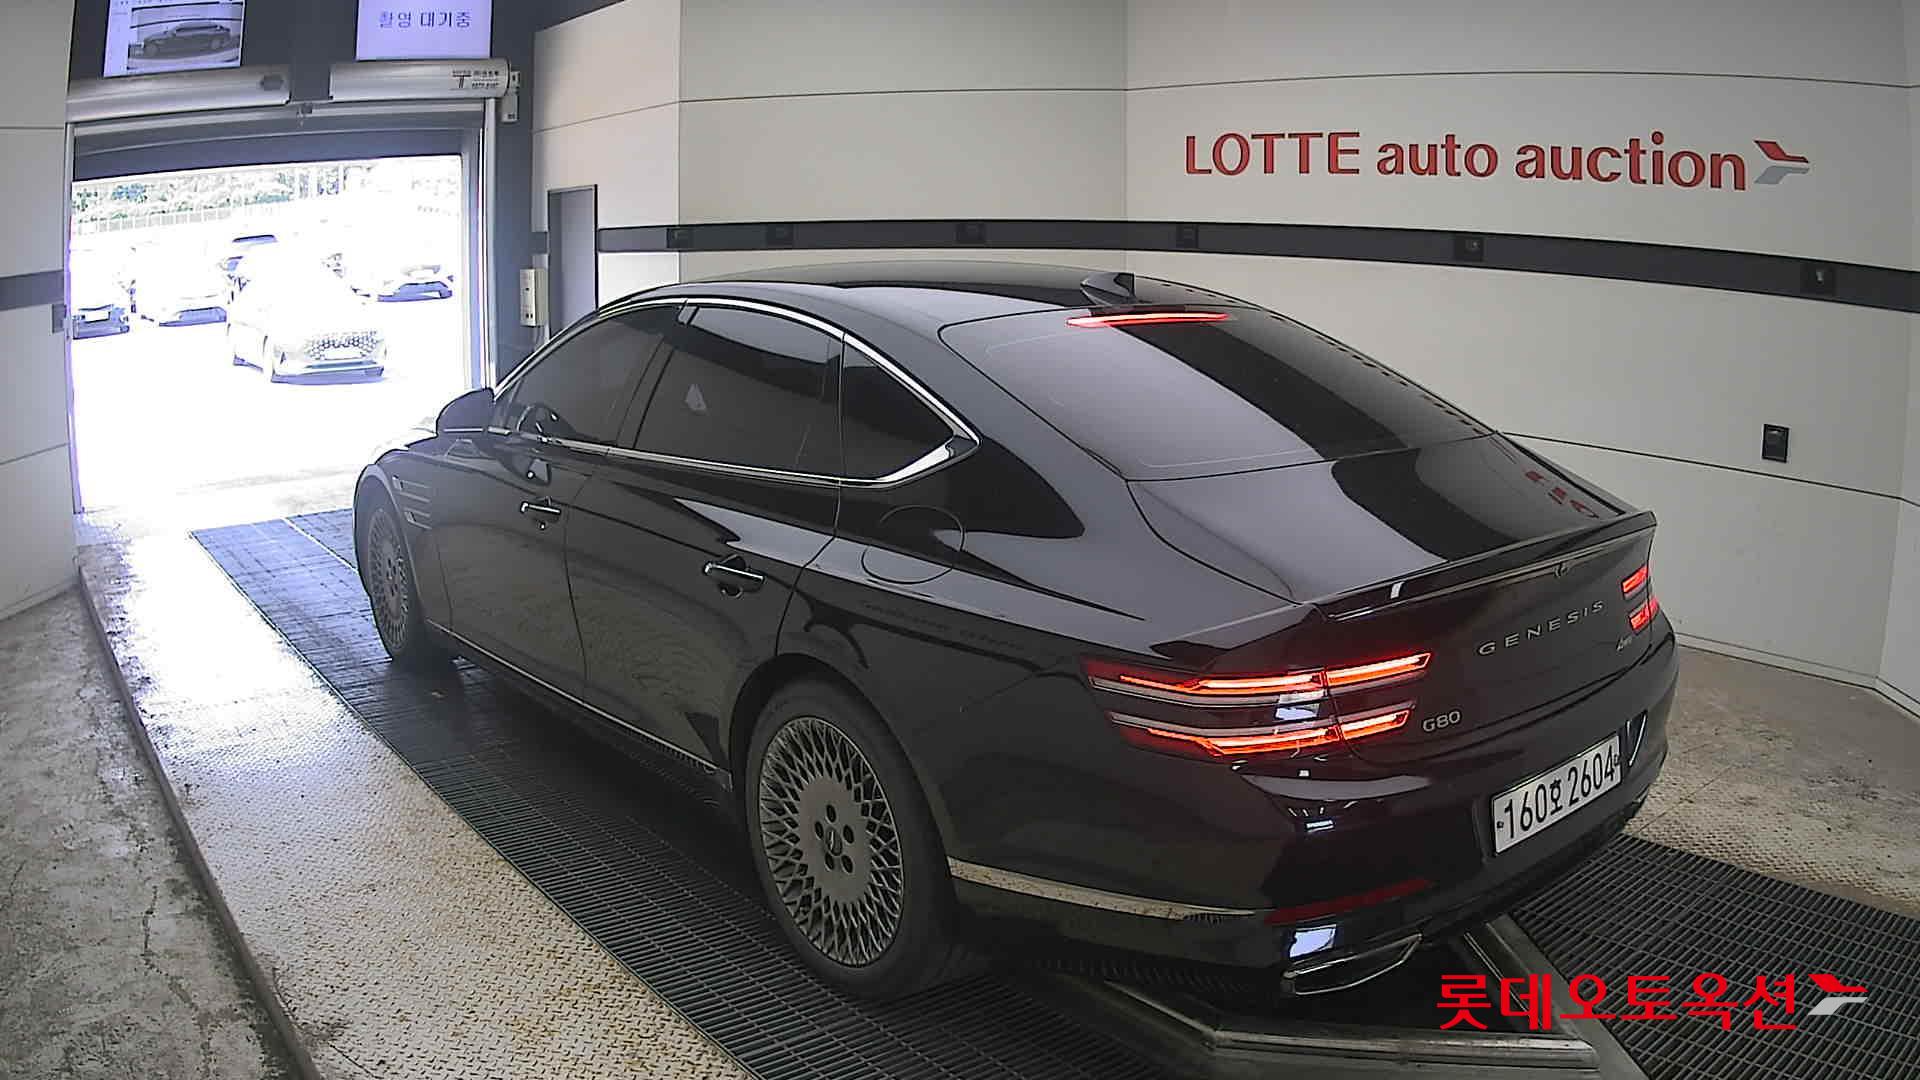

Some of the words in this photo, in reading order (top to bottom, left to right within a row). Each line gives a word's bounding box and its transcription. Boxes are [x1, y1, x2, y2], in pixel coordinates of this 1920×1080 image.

[419, 10, 473, 29] 대기중
[1185, 131, 1361, 176] LOTTE
[1375, 133, 1499, 178] auto
[1514, 130, 1747, 191] auction
[1478, 600, 1604, 656] GENESIS
[1422, 710, 1462, 732] G80
[1503, 778, 1564, 840] 160호
[1567, 744, 1616, 808] 2604
